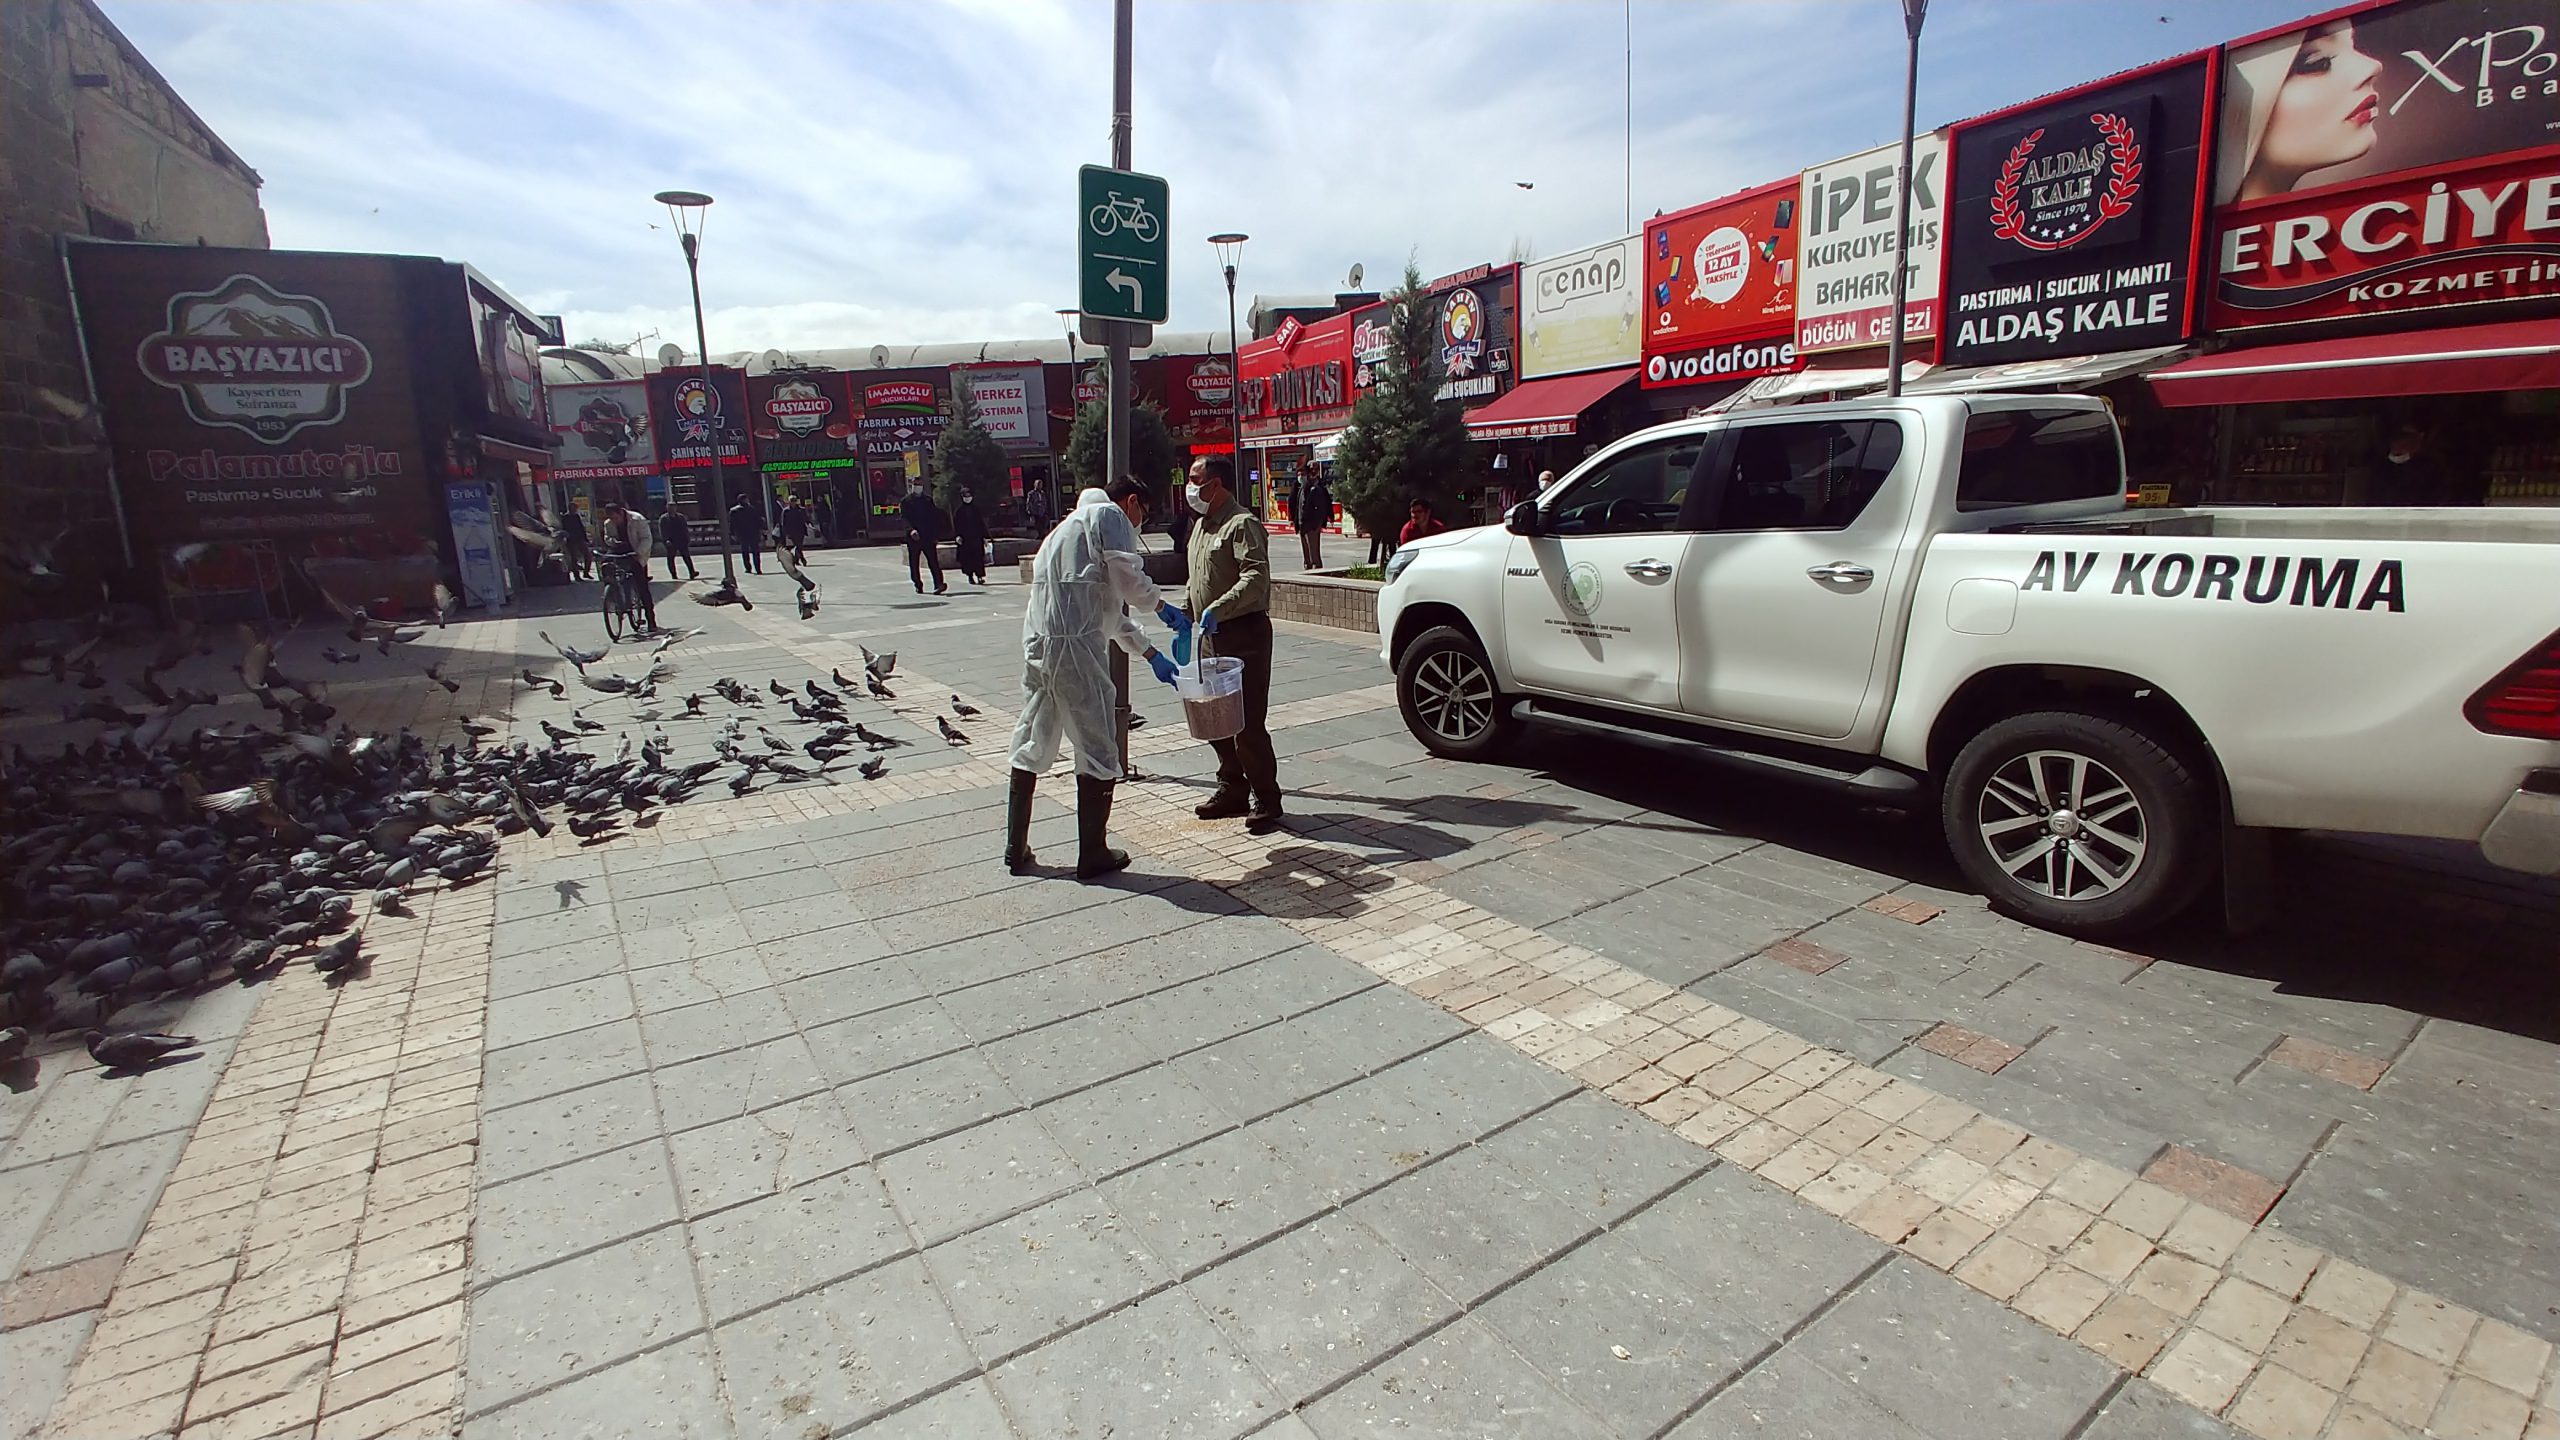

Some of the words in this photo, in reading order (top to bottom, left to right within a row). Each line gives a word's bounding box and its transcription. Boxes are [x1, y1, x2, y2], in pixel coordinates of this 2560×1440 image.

[2022, 142, 2107, 186] ALDAŞ
[1809, 151, 1939, 238] İPEK
[2031, 175, 2093, 209] KALE
[2035, 207, 2062, 223] Since
[2063, 202, 2088, 217] 1970
[1541, 258, 1621, 298] cenap
[1708, 259, 1718, 272] 12
[1719, 255, 1735, 269] AY
[1816, 264, 1921, 305] BAHART
[1959, 284, 2032, 312] PASTIRMA
[2046, 274, 2101, 299] SUCUK
[2115, 262, 2172, 290] MANTI
[1802, 320, 1856, 347] DÜĞÜN
[1869, 305, 1931, 341] ÇEEZİ
[1956, 307, 2064, 343] ALDAŞ
[2073, 292, 2169, 333] KALE
[164, 346, 344, 377] BAŞYAZICI
[1669, 342, 1795, 380] vodafone
[1192, 376, 1233, 390] BAŞYAZIC
[772, 400, 826, 415] BAŞYAZICI
[979, 406, 1024, 417] ASTIRMA
[1208, 406, 1234, 416] PASTIR
[256, 420, 287, 431] 1953
[147, 444, 401, 482] Palamutoğlu
[694, 444, 739, 457] SUCLARI
[185, 489, 261, 503] Pastırma
[271, 487, 323, 500] Sucuk
[2020, 550, 2100, 593] AV
[2111, 552, 2406, 613] KORUMA
